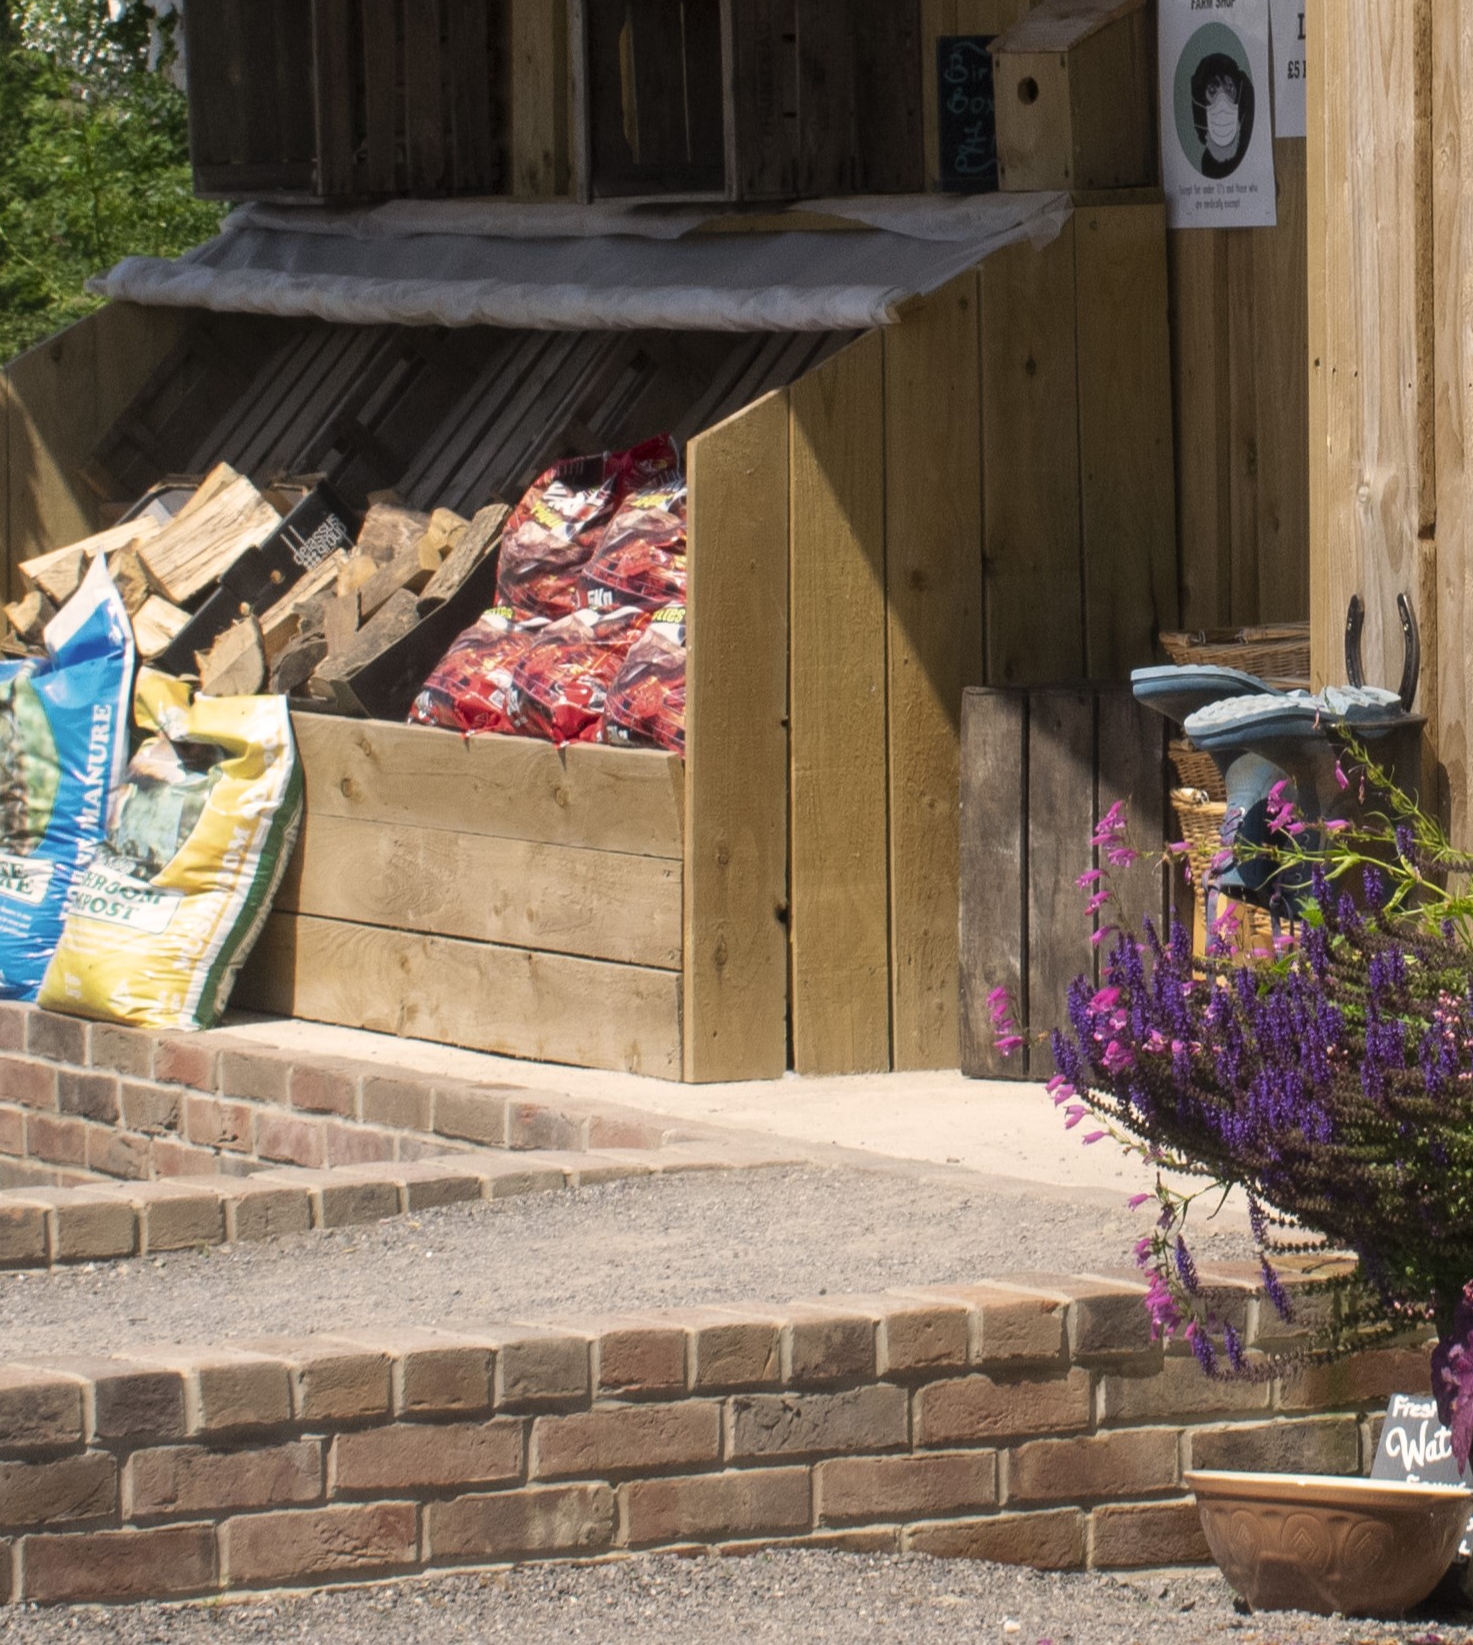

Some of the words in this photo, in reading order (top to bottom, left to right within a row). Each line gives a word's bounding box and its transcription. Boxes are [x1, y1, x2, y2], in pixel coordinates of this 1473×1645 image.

[944, 51, 989, 84] Bir
[1287, 59, 1301, 79] £5
[79, 704, 112, 831] MANURE
[1385, 1420, 1453, 1472] Wat
